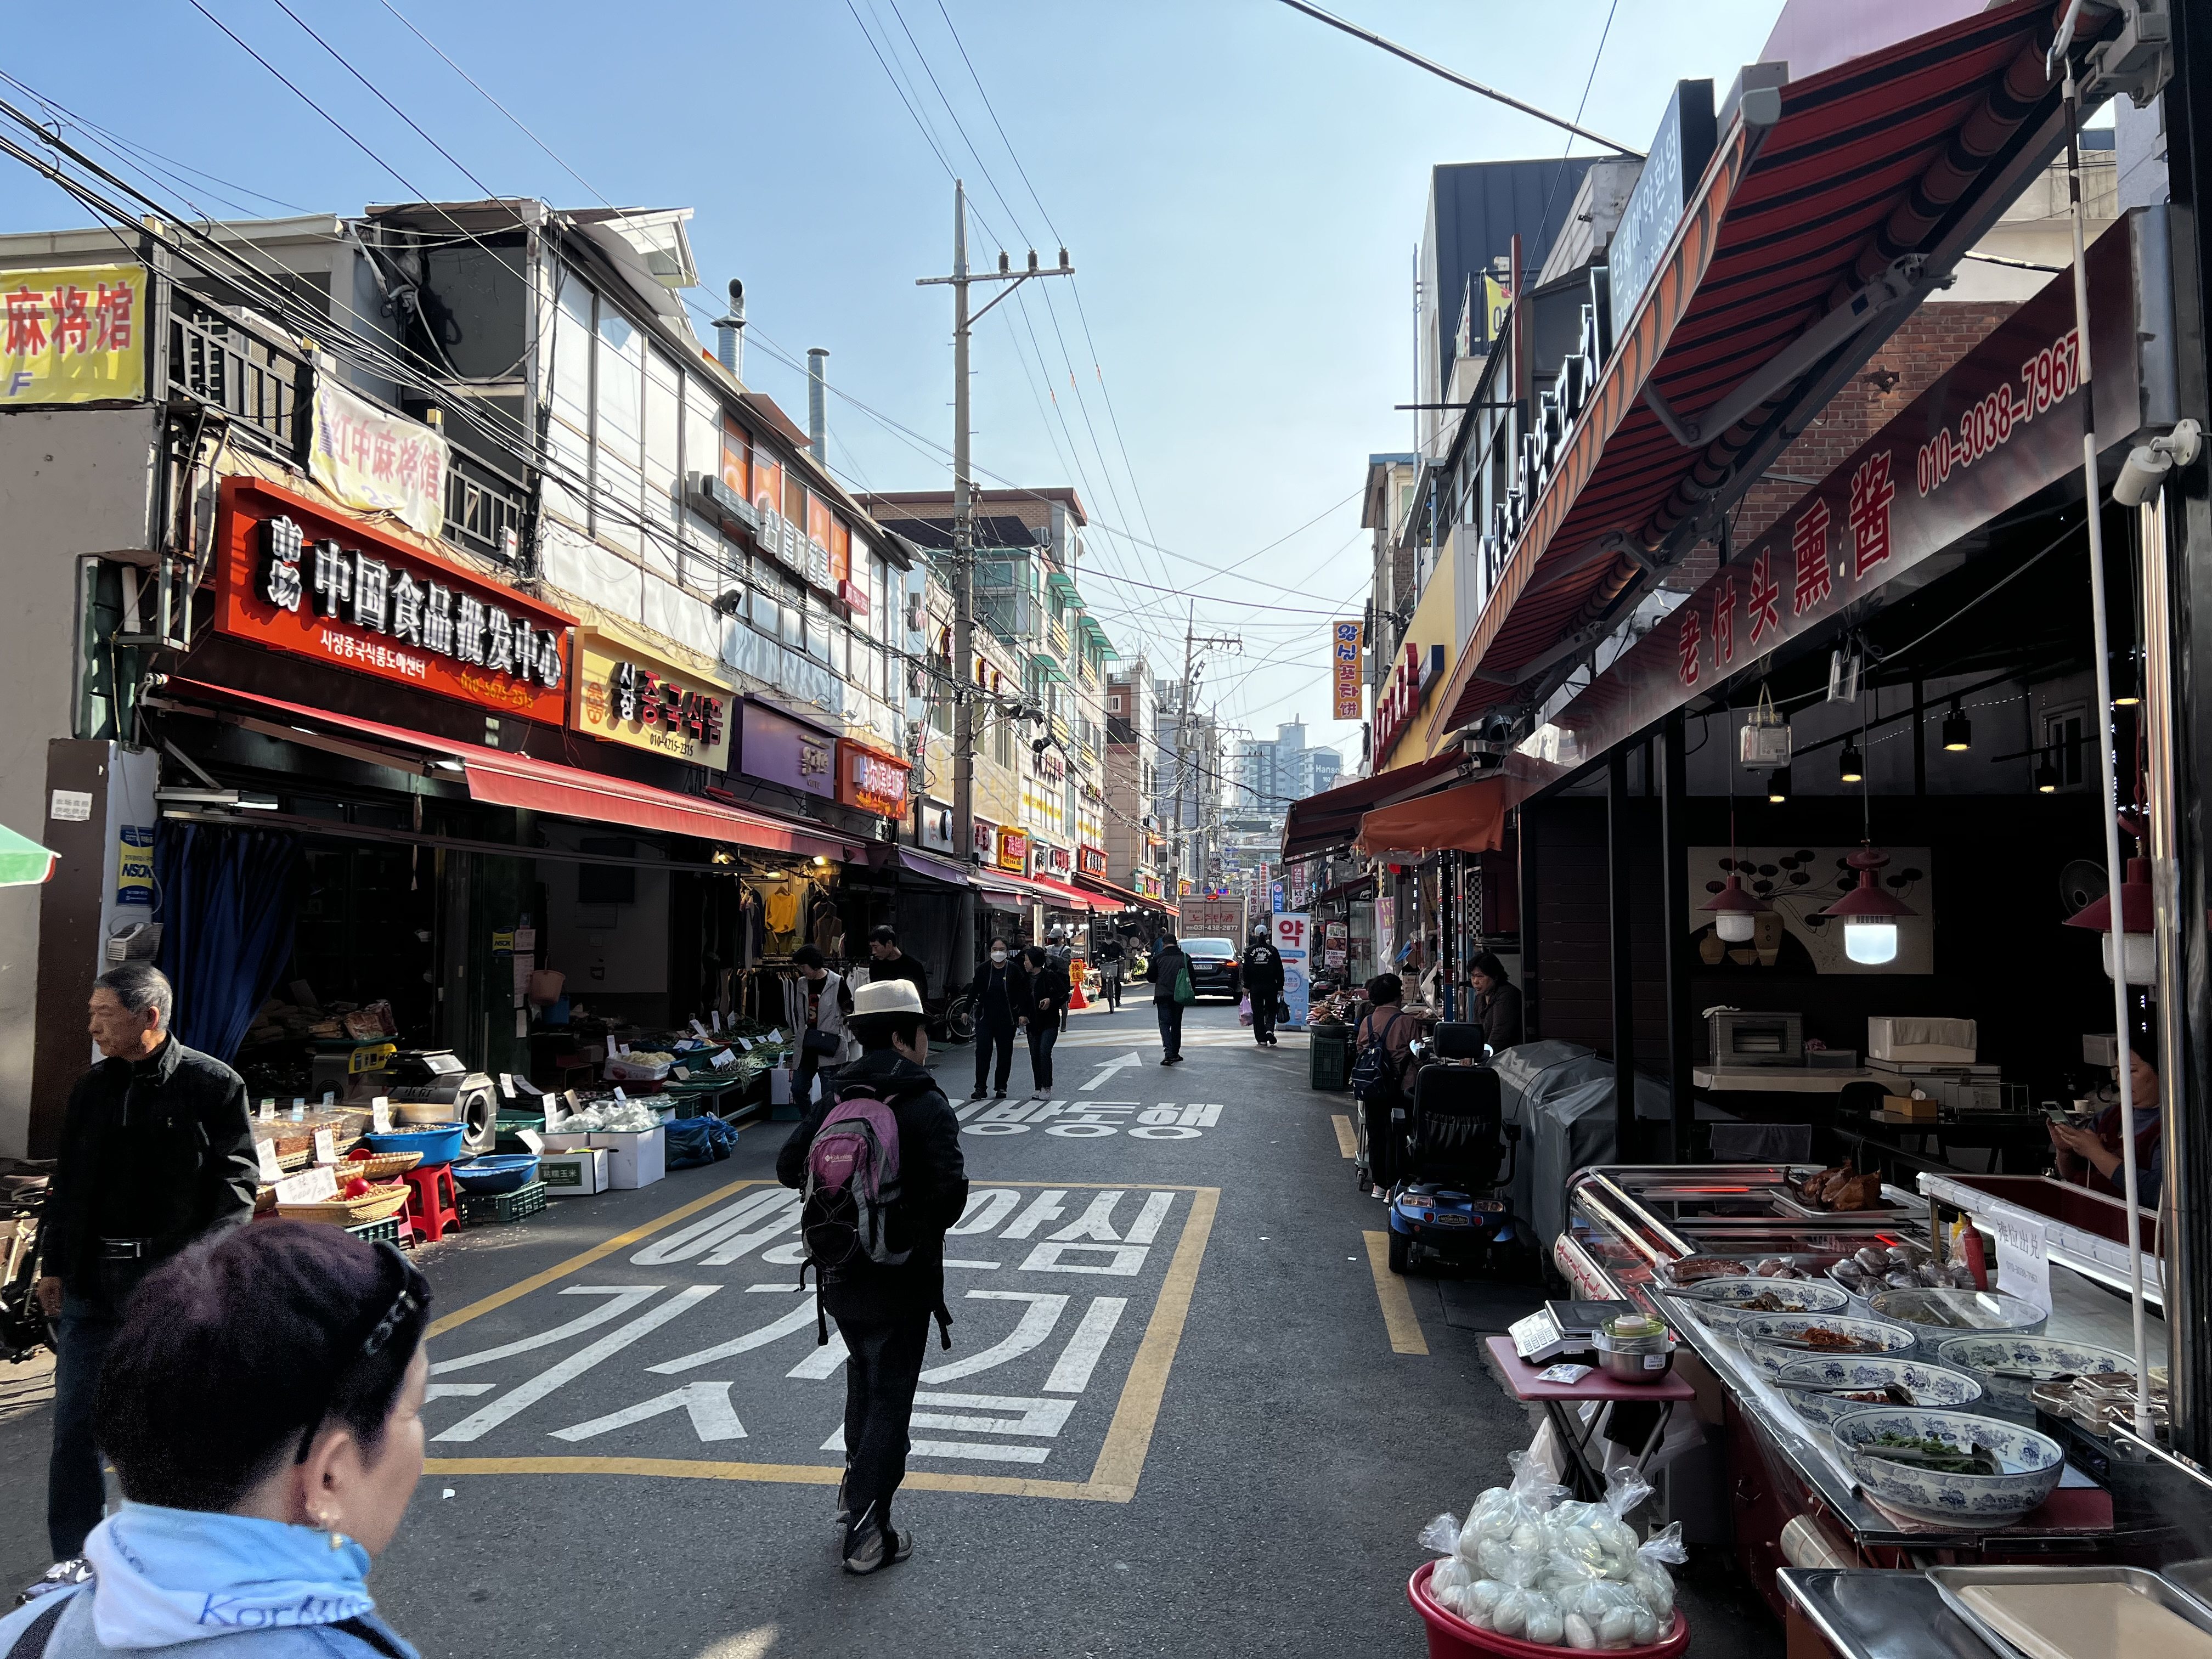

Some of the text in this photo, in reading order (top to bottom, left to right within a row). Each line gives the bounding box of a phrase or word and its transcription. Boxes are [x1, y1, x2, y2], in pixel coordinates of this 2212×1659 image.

[1613, 117, 1677, 296] 단체예약환영
[5, 281, 134, 356] 麻将馆
[1916, 328, 2081, 498] 010-3038-7967
[331, 414, 441, 503] 红中麻将馆
[269, 515, 303, 612] 市场
[1679, 448, 1895, 687] 老付头熏酱
[314, 539, 562, 689] 中国食品批发中心
[619, 662, 636, 720] 시장
[641, 669, 724, 746] 중국식품
[650, 733, 693, 757] 010-4215-2315
[1071, 963, 1081, 980] 换钱
[1250, 946, 1272, 957] LIFEWORK
[1279, 920, 1305, 947] 약
[629, 1189, 1176, 1276] 여안심
[1996, 1218, 2040, 1259] 摊位出兑
